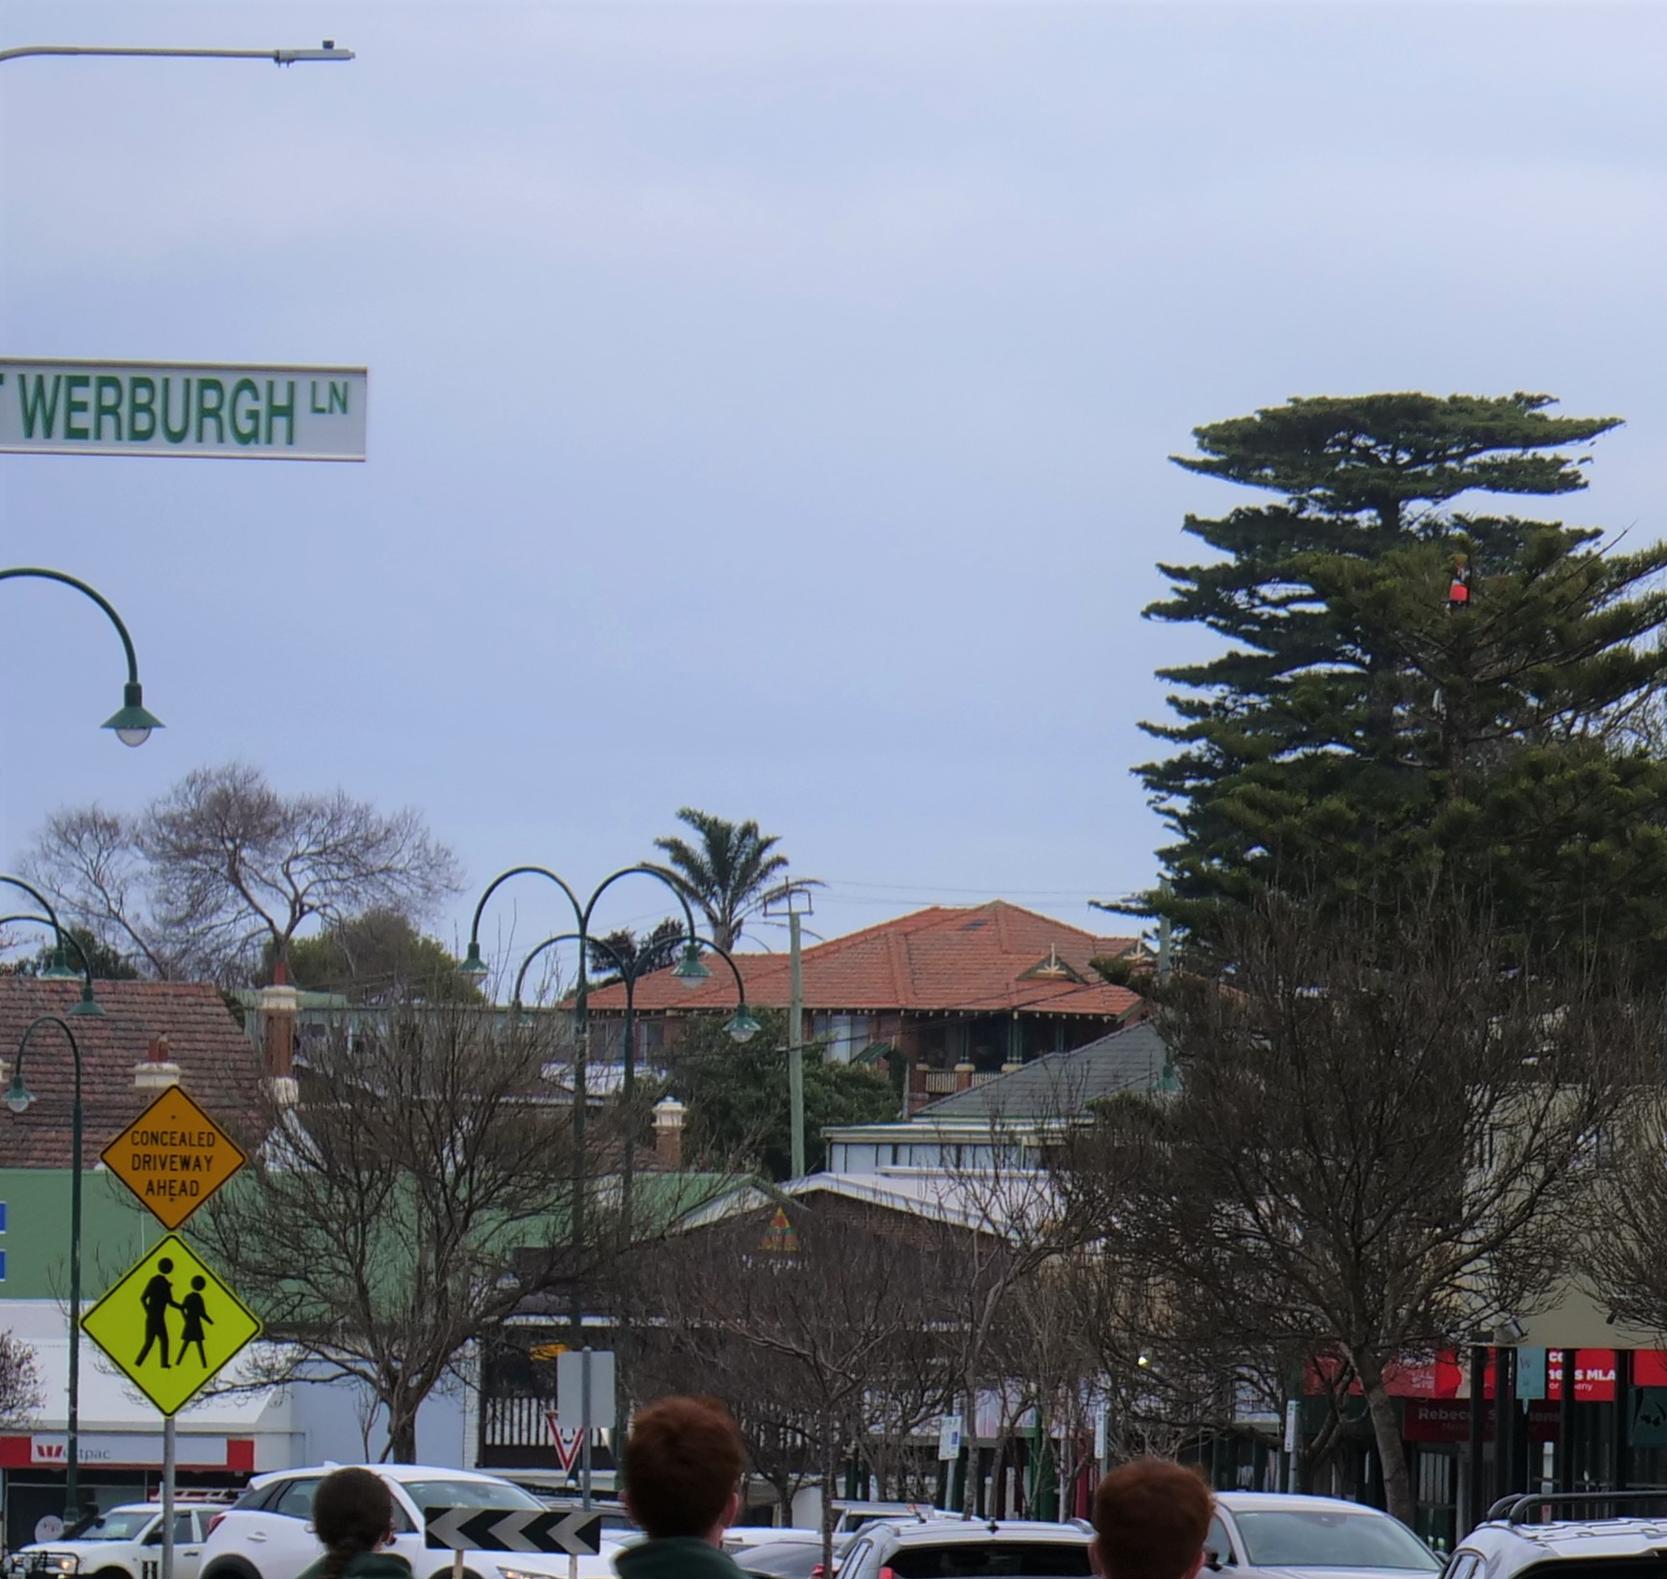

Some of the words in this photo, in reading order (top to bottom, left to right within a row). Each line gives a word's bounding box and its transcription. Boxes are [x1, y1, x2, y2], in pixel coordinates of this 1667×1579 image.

[17, 373, 296, 446] WERBURGH
[309, 379, 349, 415] LN
[130, 1130, 216, 1148] CONCEALED
[131, 1153, 214, 1172] DRIVEWAY
[145, 1179, 200, 1198] AHEAD
[1586, 1369, 1616, 1381] MLA
[1418, 1407, 1473, 1421] Rebec
[36, 1445, 112, 1464] Wtpac
